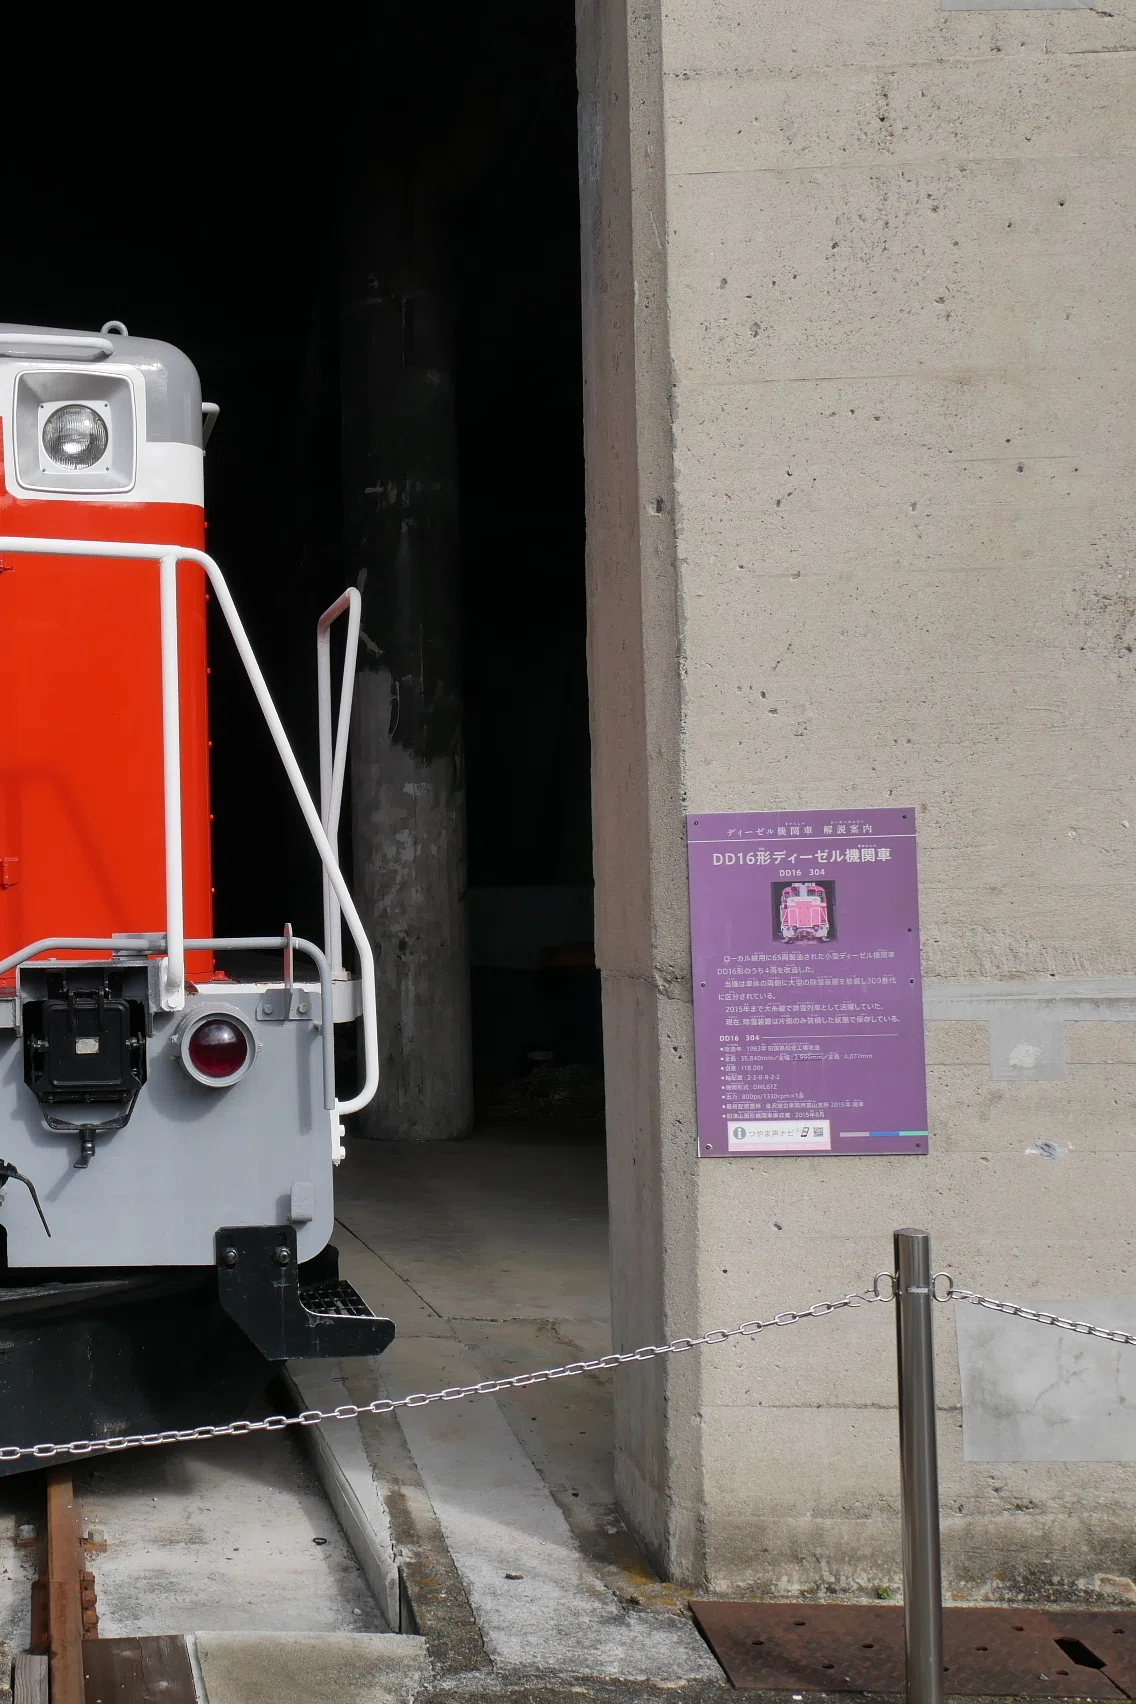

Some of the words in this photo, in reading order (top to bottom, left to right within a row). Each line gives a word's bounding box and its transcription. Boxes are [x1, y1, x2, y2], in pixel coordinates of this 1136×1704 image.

[726, 825, 813, 837] ディーゼル機関車
[823, 823, 873, 835] 解説案内
[713, 848, 892, 866] DD16形ディーゼル機関車
[779, 869, 802, 877] DD16
[809, 868, 825, 876] 304
[748, 1128, 795, 1138] つやま声ナビ
